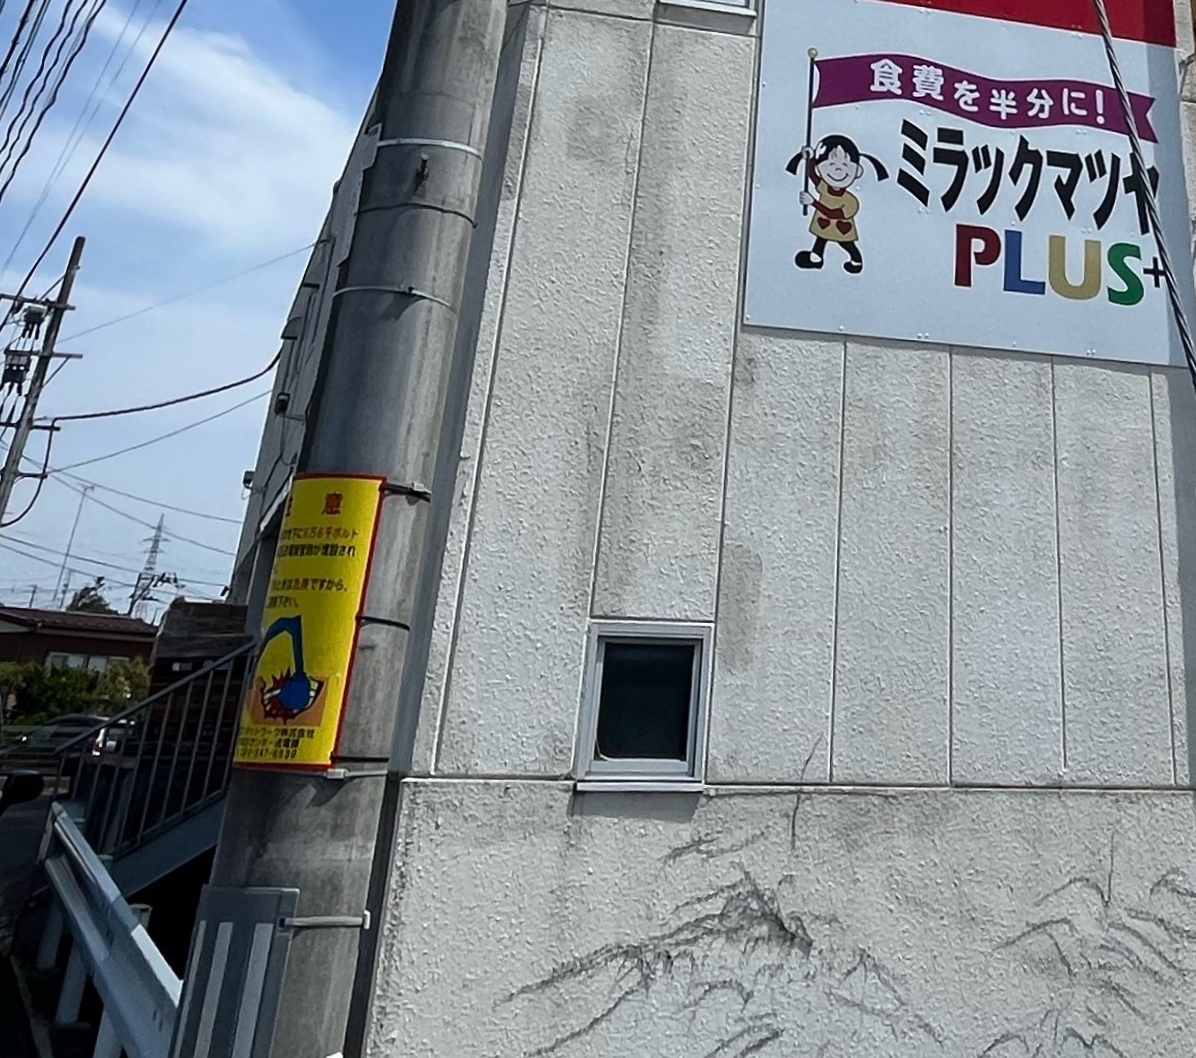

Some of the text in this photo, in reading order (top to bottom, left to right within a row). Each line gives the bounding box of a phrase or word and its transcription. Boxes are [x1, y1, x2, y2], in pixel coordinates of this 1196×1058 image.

[870, 58, 1106, 125] 食費を半分に!
